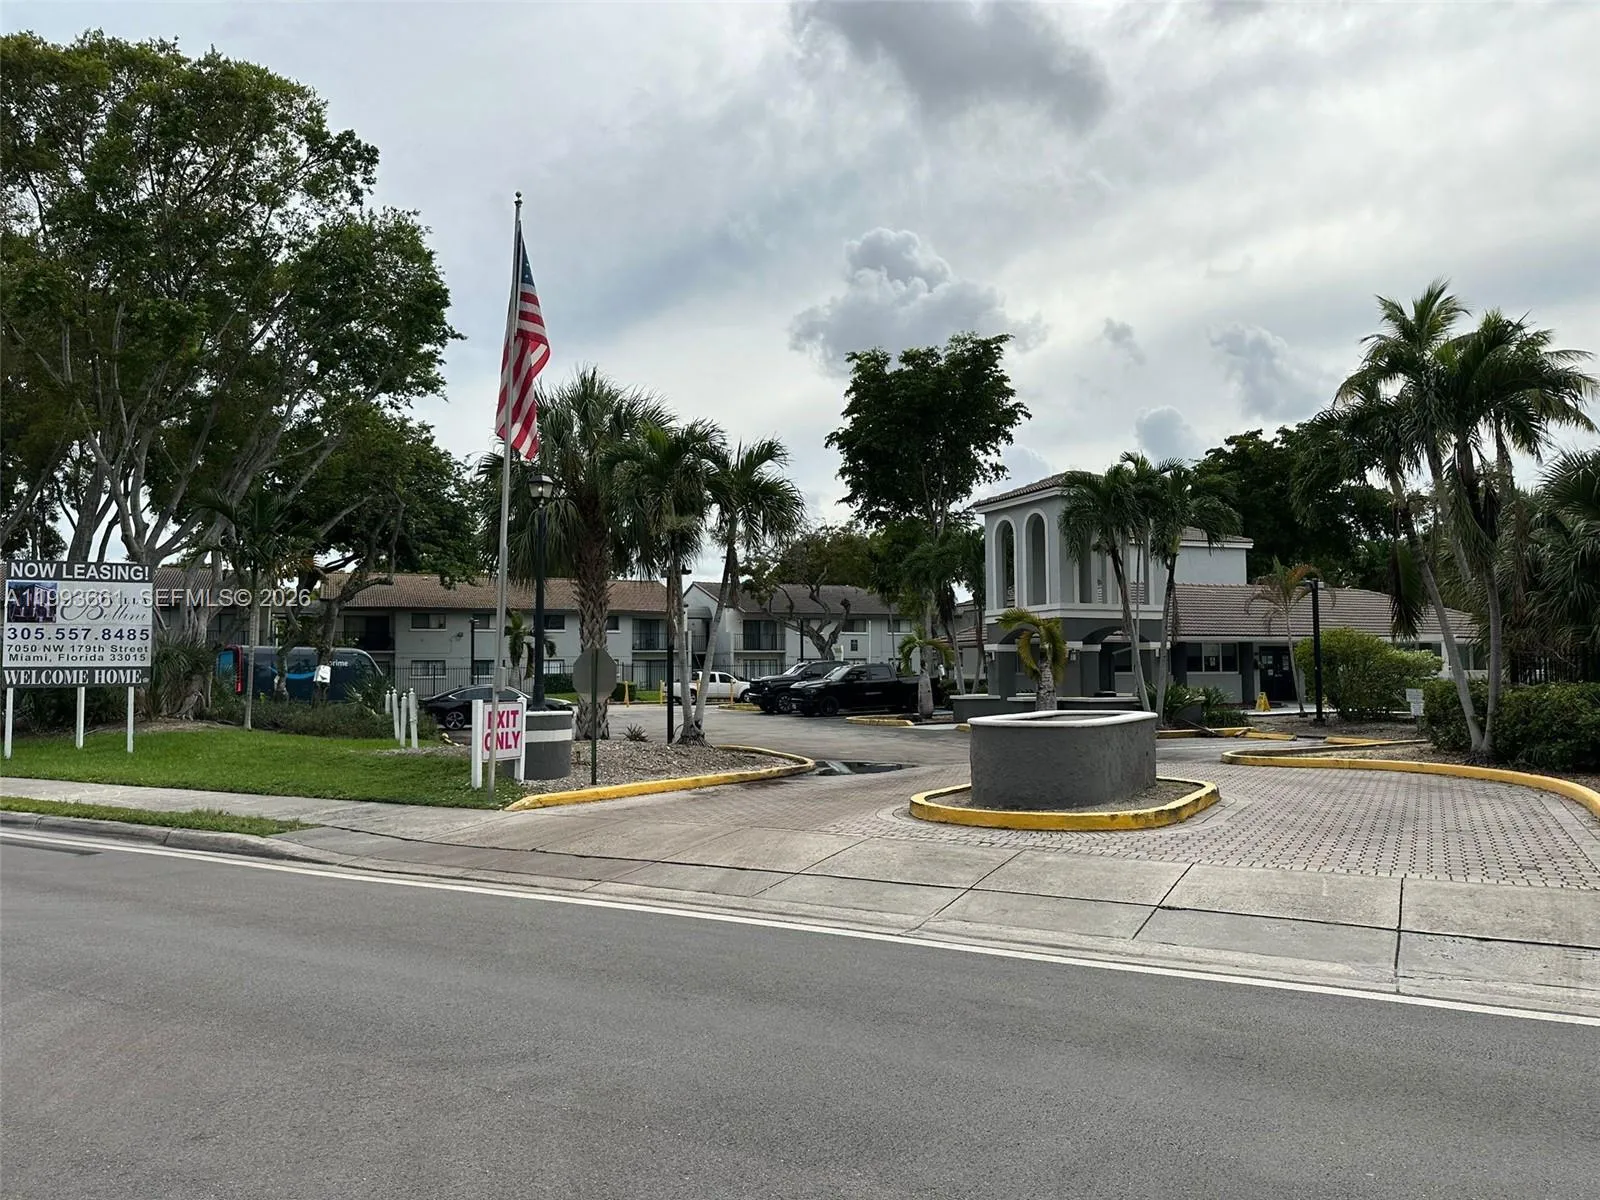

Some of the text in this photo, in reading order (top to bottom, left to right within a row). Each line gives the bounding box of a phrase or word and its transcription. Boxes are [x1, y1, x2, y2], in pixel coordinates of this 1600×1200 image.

[10, 562, 149, 580] NOW LEASING!
[7, 627, 150, 641] 305.557.8485
[7, 645, 149, 653] 7050 NW 179th Street
[9, 654, 146, 663] Miami, Florida 33015
[3, 669, 142, 685] WELCOME HOME
[485, 731, 520, 752] ONLY
